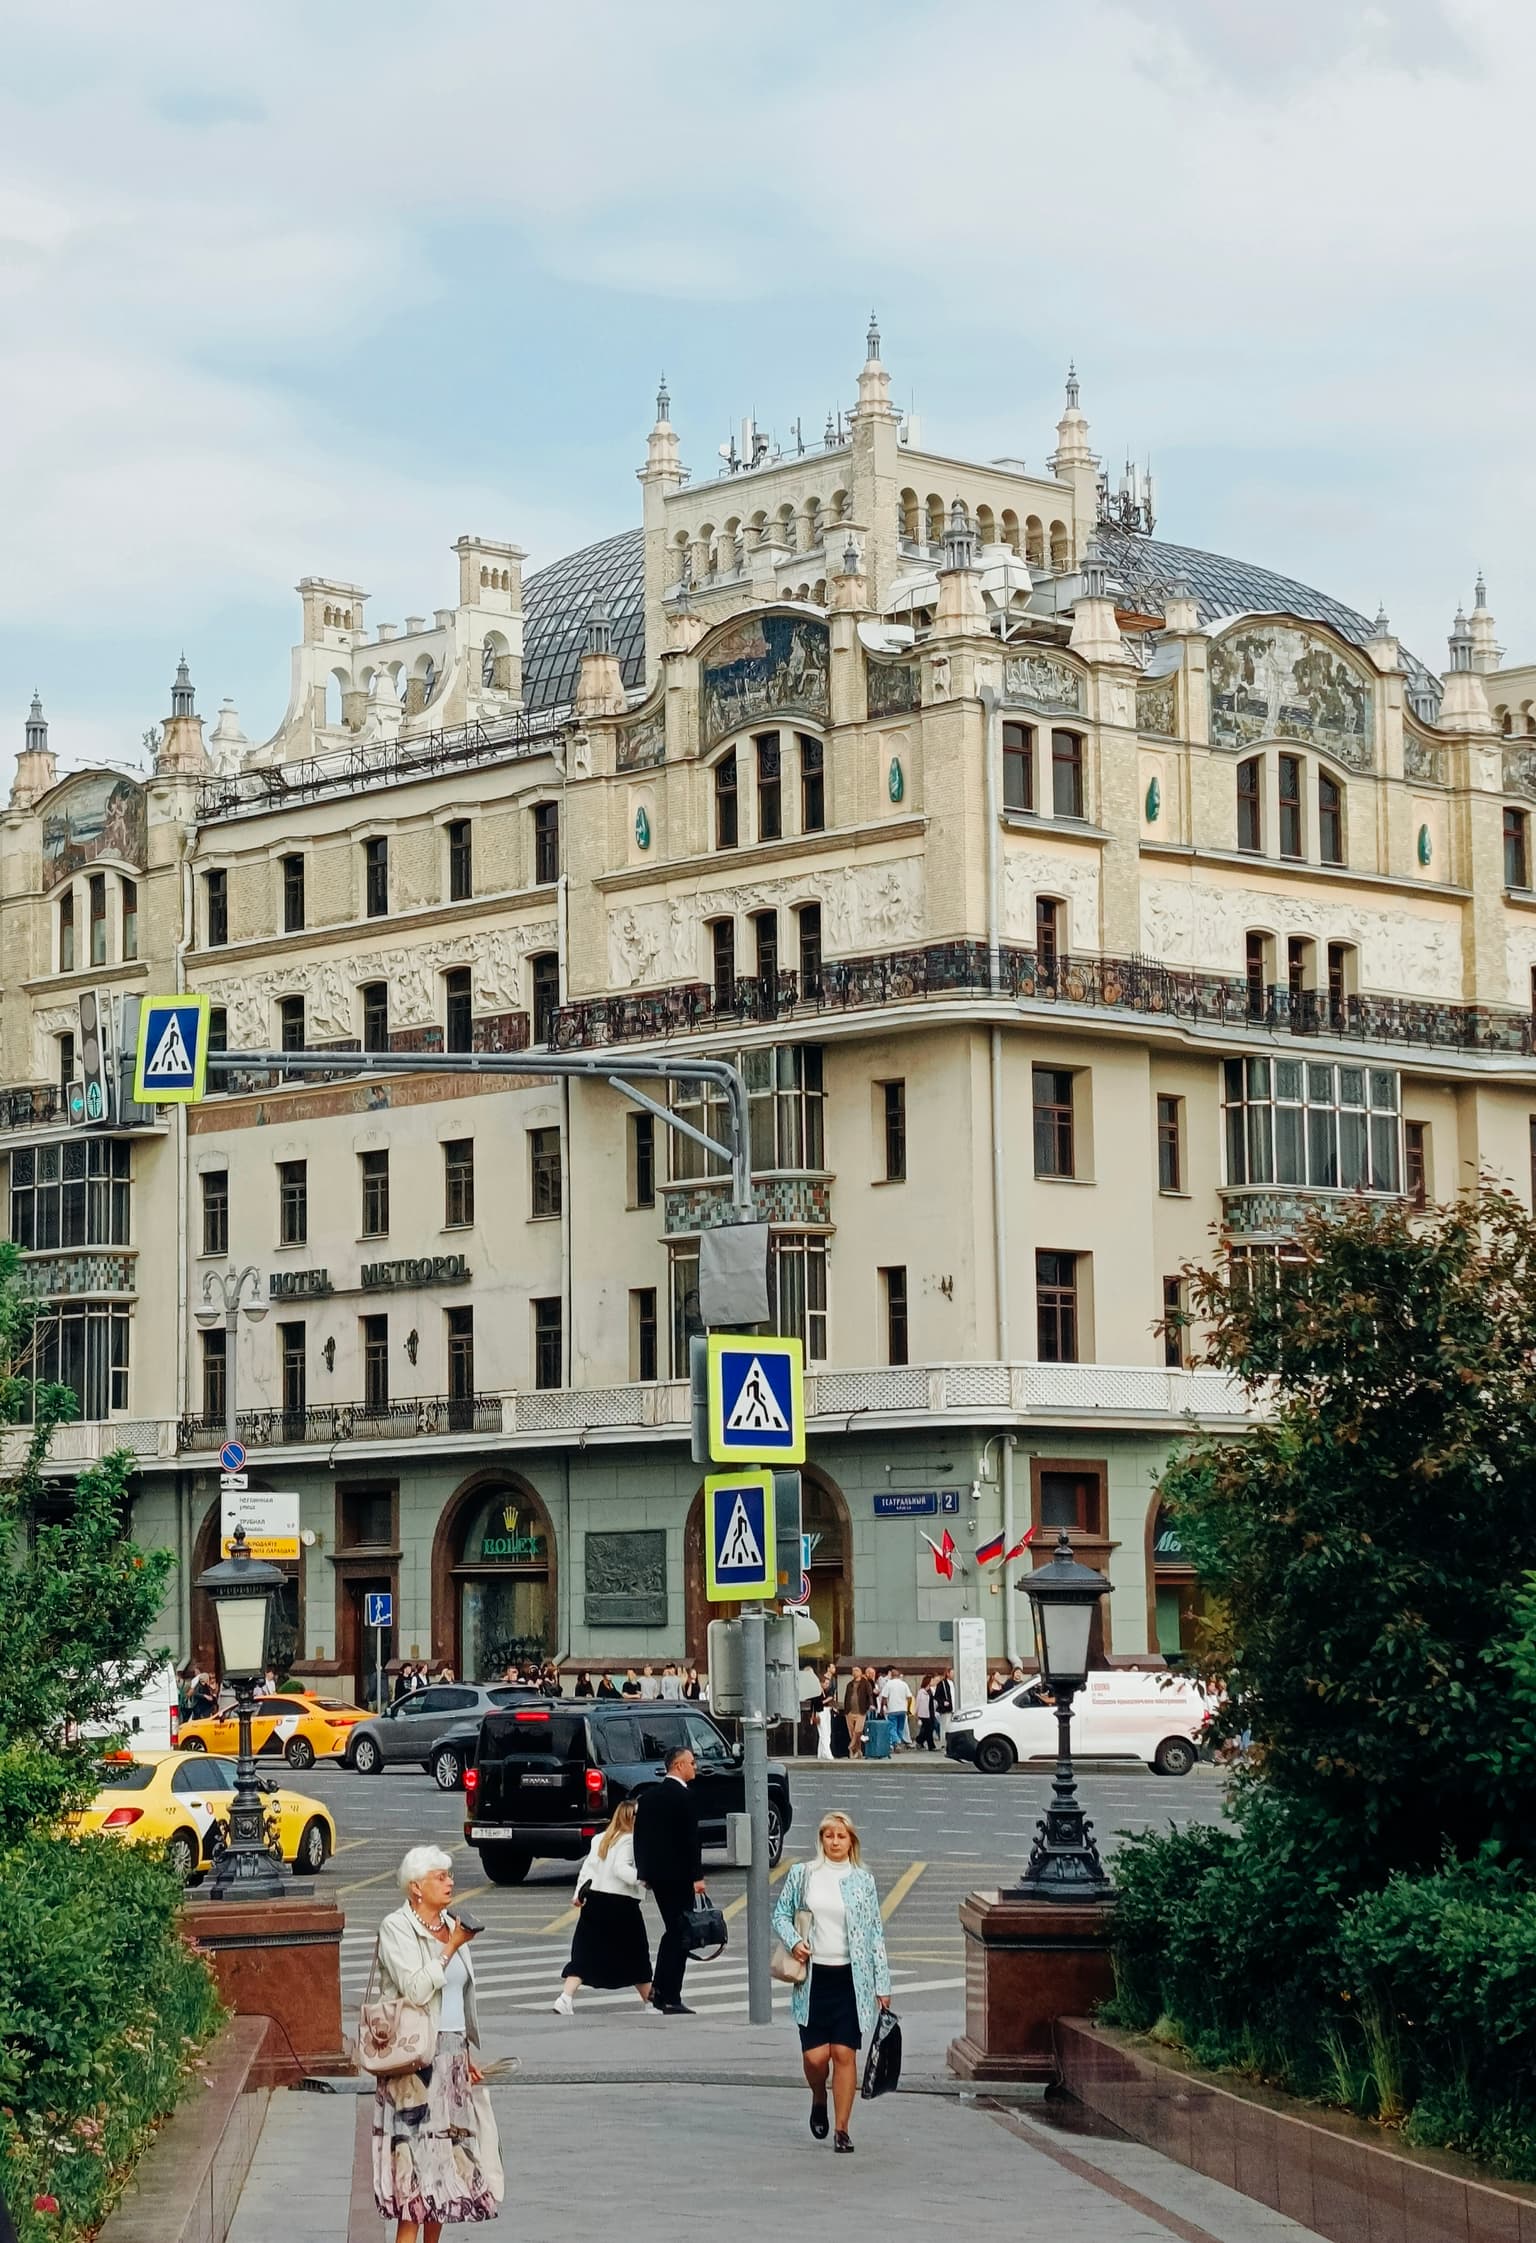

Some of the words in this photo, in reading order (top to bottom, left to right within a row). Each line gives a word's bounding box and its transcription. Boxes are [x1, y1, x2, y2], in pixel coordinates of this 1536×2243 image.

[269, 1268, 334, 1295] HOTEL
[360, 1254, 471, 1288] METROPOL
[944, 1494, 953, 1509] 2
[483, 1537, 539, 1555] ROLEX
